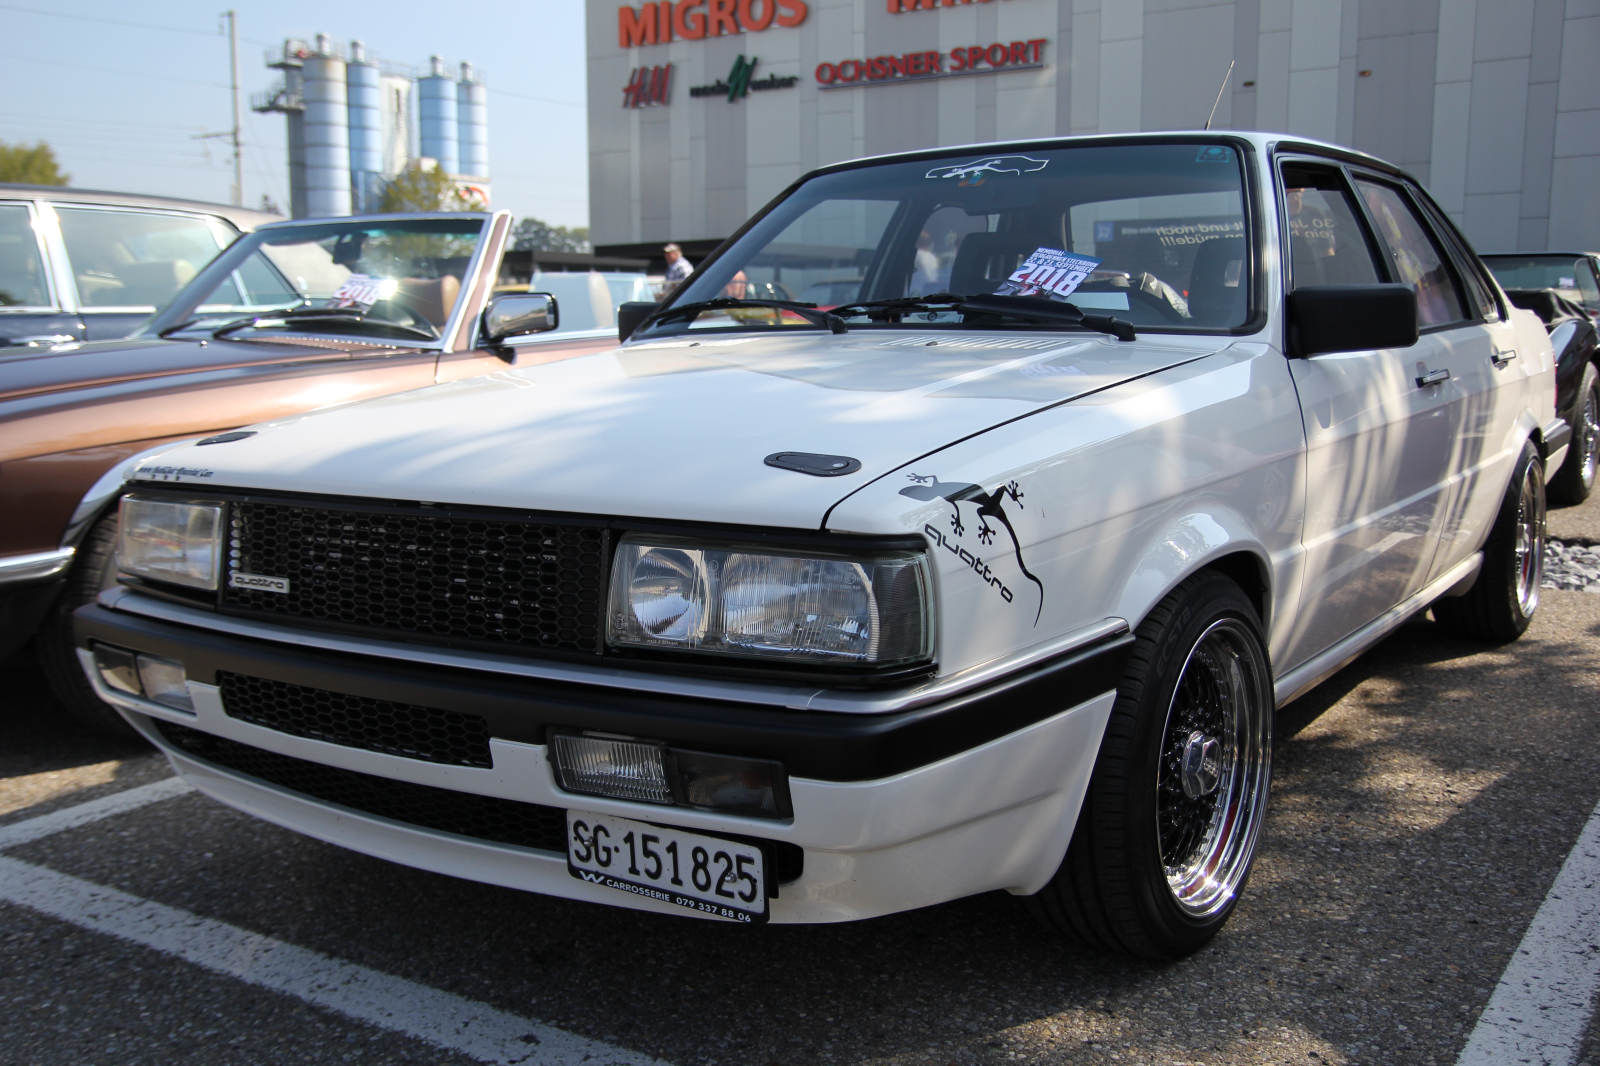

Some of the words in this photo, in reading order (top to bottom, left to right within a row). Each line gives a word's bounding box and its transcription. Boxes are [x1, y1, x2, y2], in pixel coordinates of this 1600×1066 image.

[618, 0, 808, 47] MIGROS
[815, 52, 940, 84] OCHSNER
[949, 39, 1047, 71] SPORT
[1008, 262, 1088, 297] 2018
[1054, 261, 1095, 274] SEPTEMBER
[333, 283, 380, 306] 2018
[234, 575, 285, 590] quattro
[925, 523, 1013, 604] quattro
[606, 878, 671, 902] CARROSSERIE
[676, 896, 696, 909] 079
[698, 901, 718, 915] 337
[721, 906, 735, 918] 88
[737, 911, 752, 923] 06
